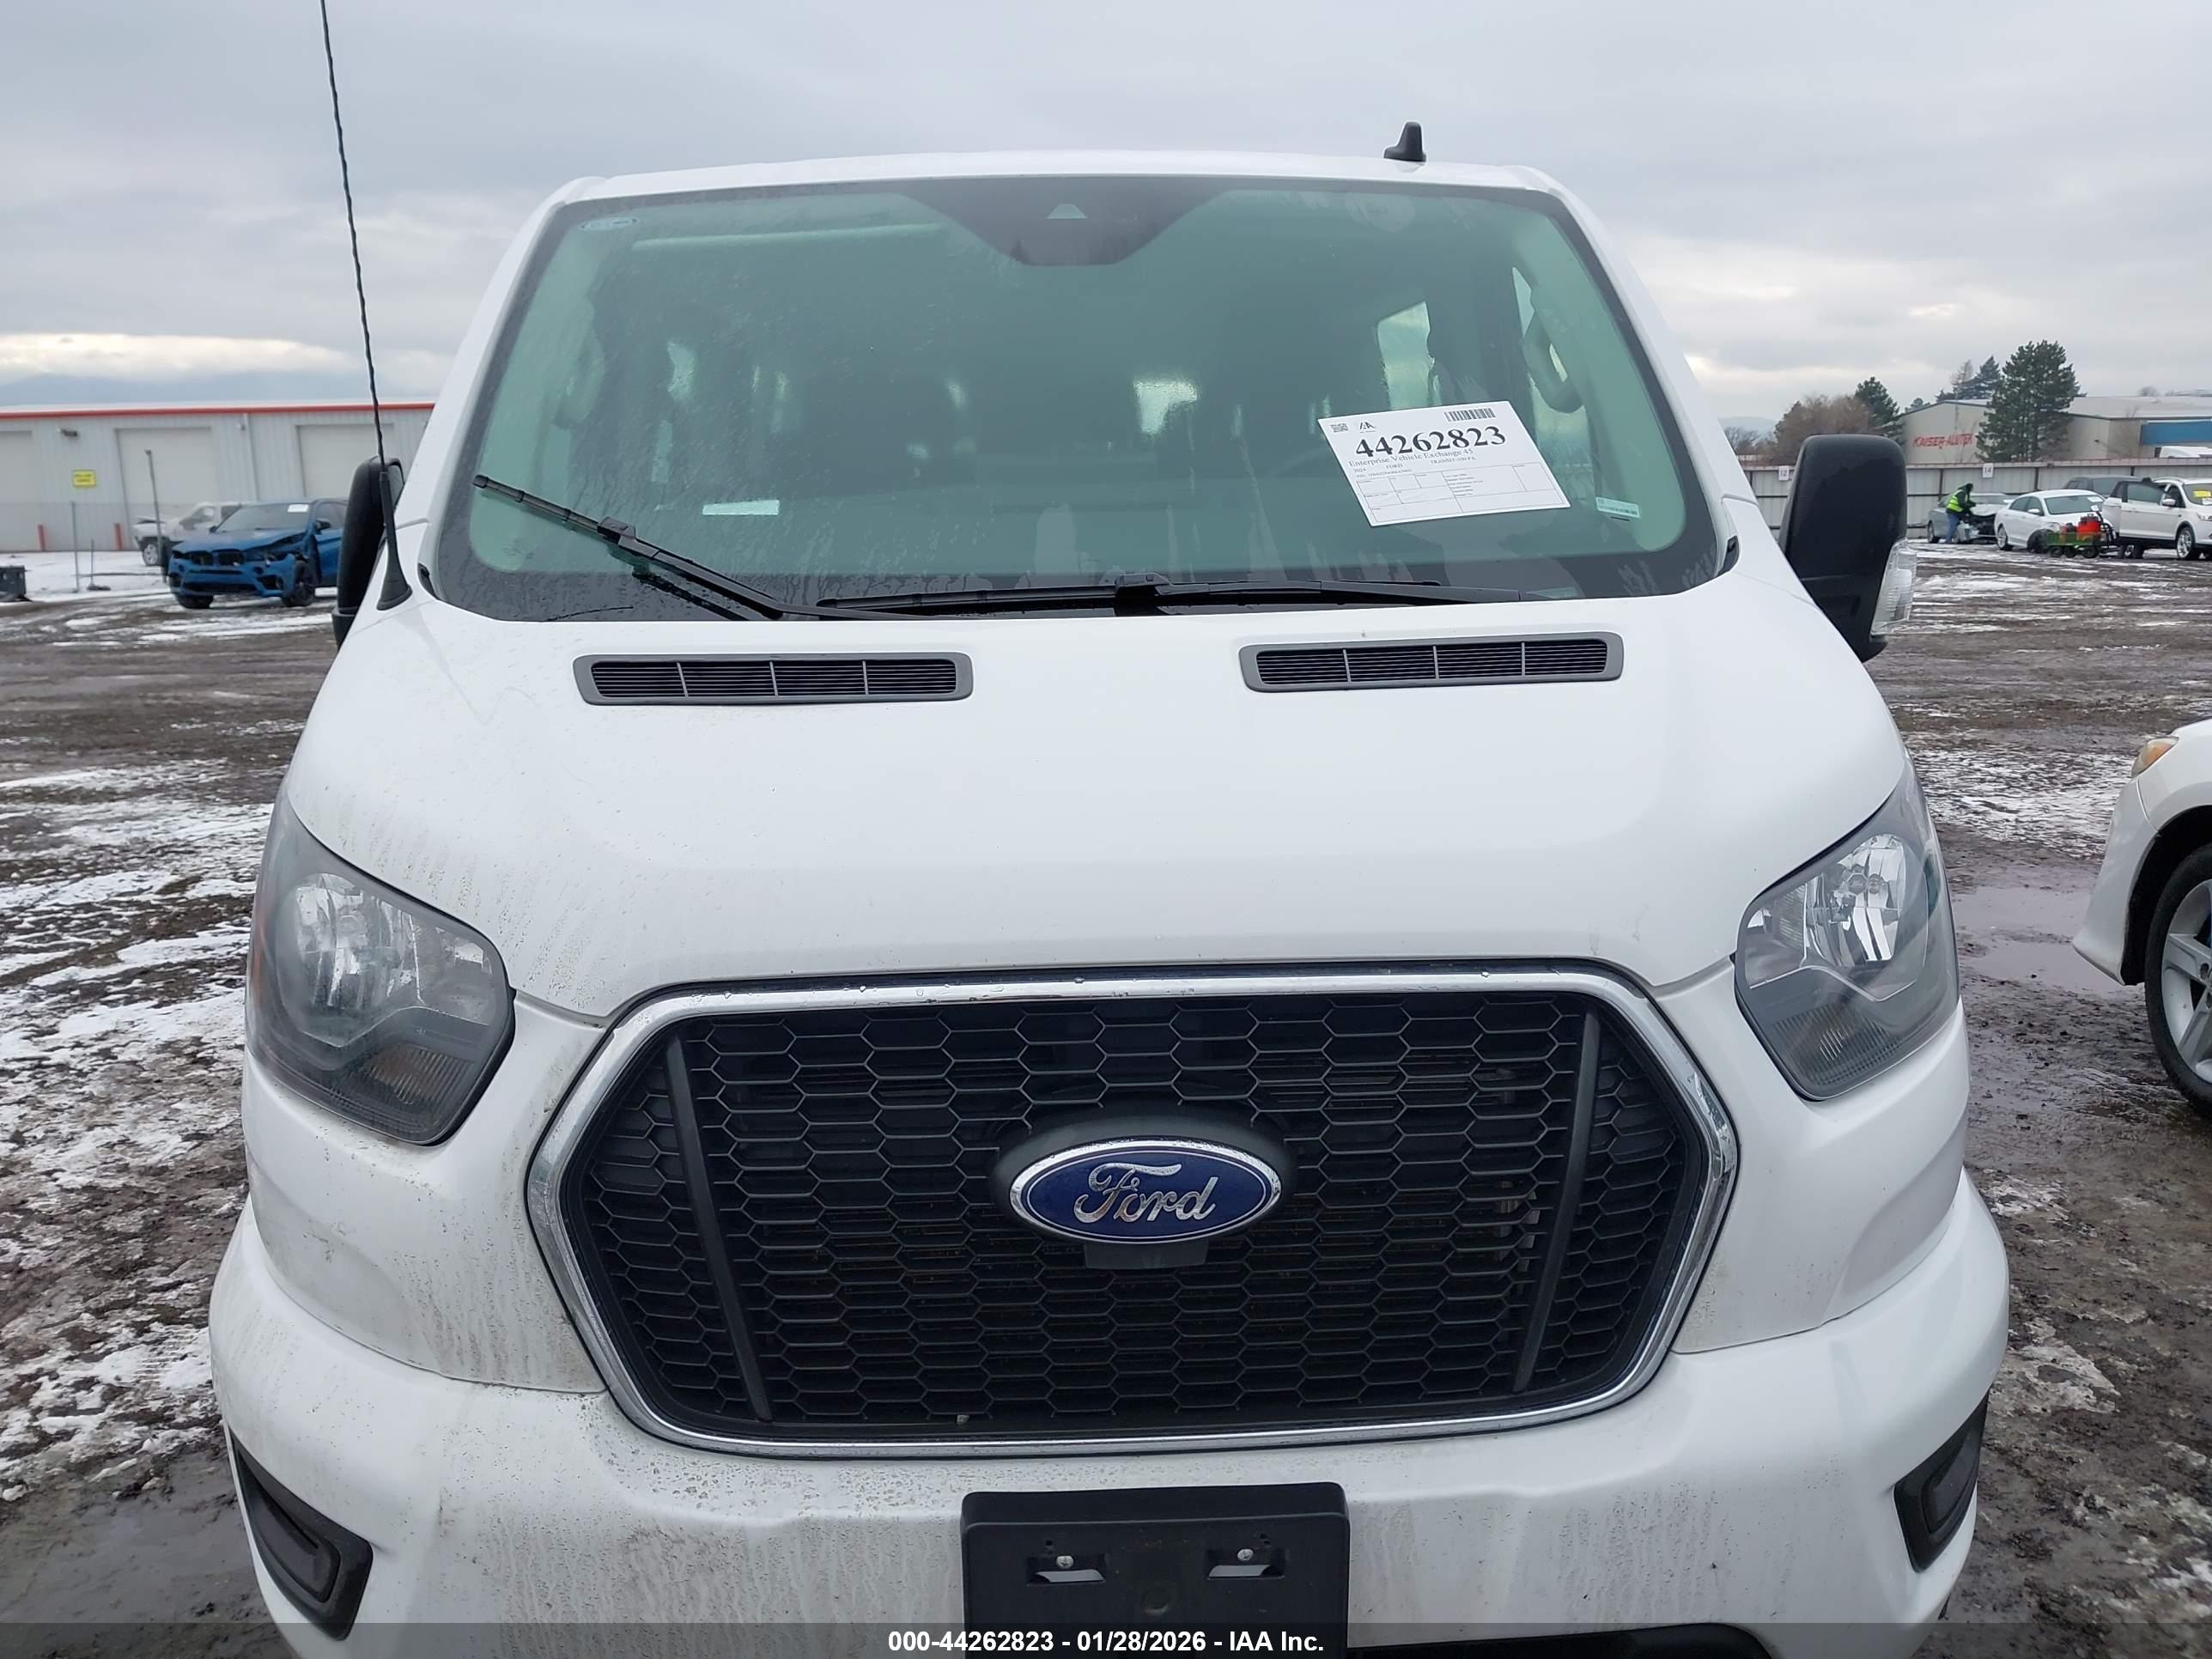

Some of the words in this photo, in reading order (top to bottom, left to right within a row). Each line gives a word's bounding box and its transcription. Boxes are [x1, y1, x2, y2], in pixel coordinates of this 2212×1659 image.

[1355, 426, 1506, 457] 44262823
[1348, 459, 1389, 467] Enterprise
[1391, 452, 1422, 462] Vehicle
[1423, 449, 1462, 459] Exchange
[1073, 1161, 1219, 1224] Ford
